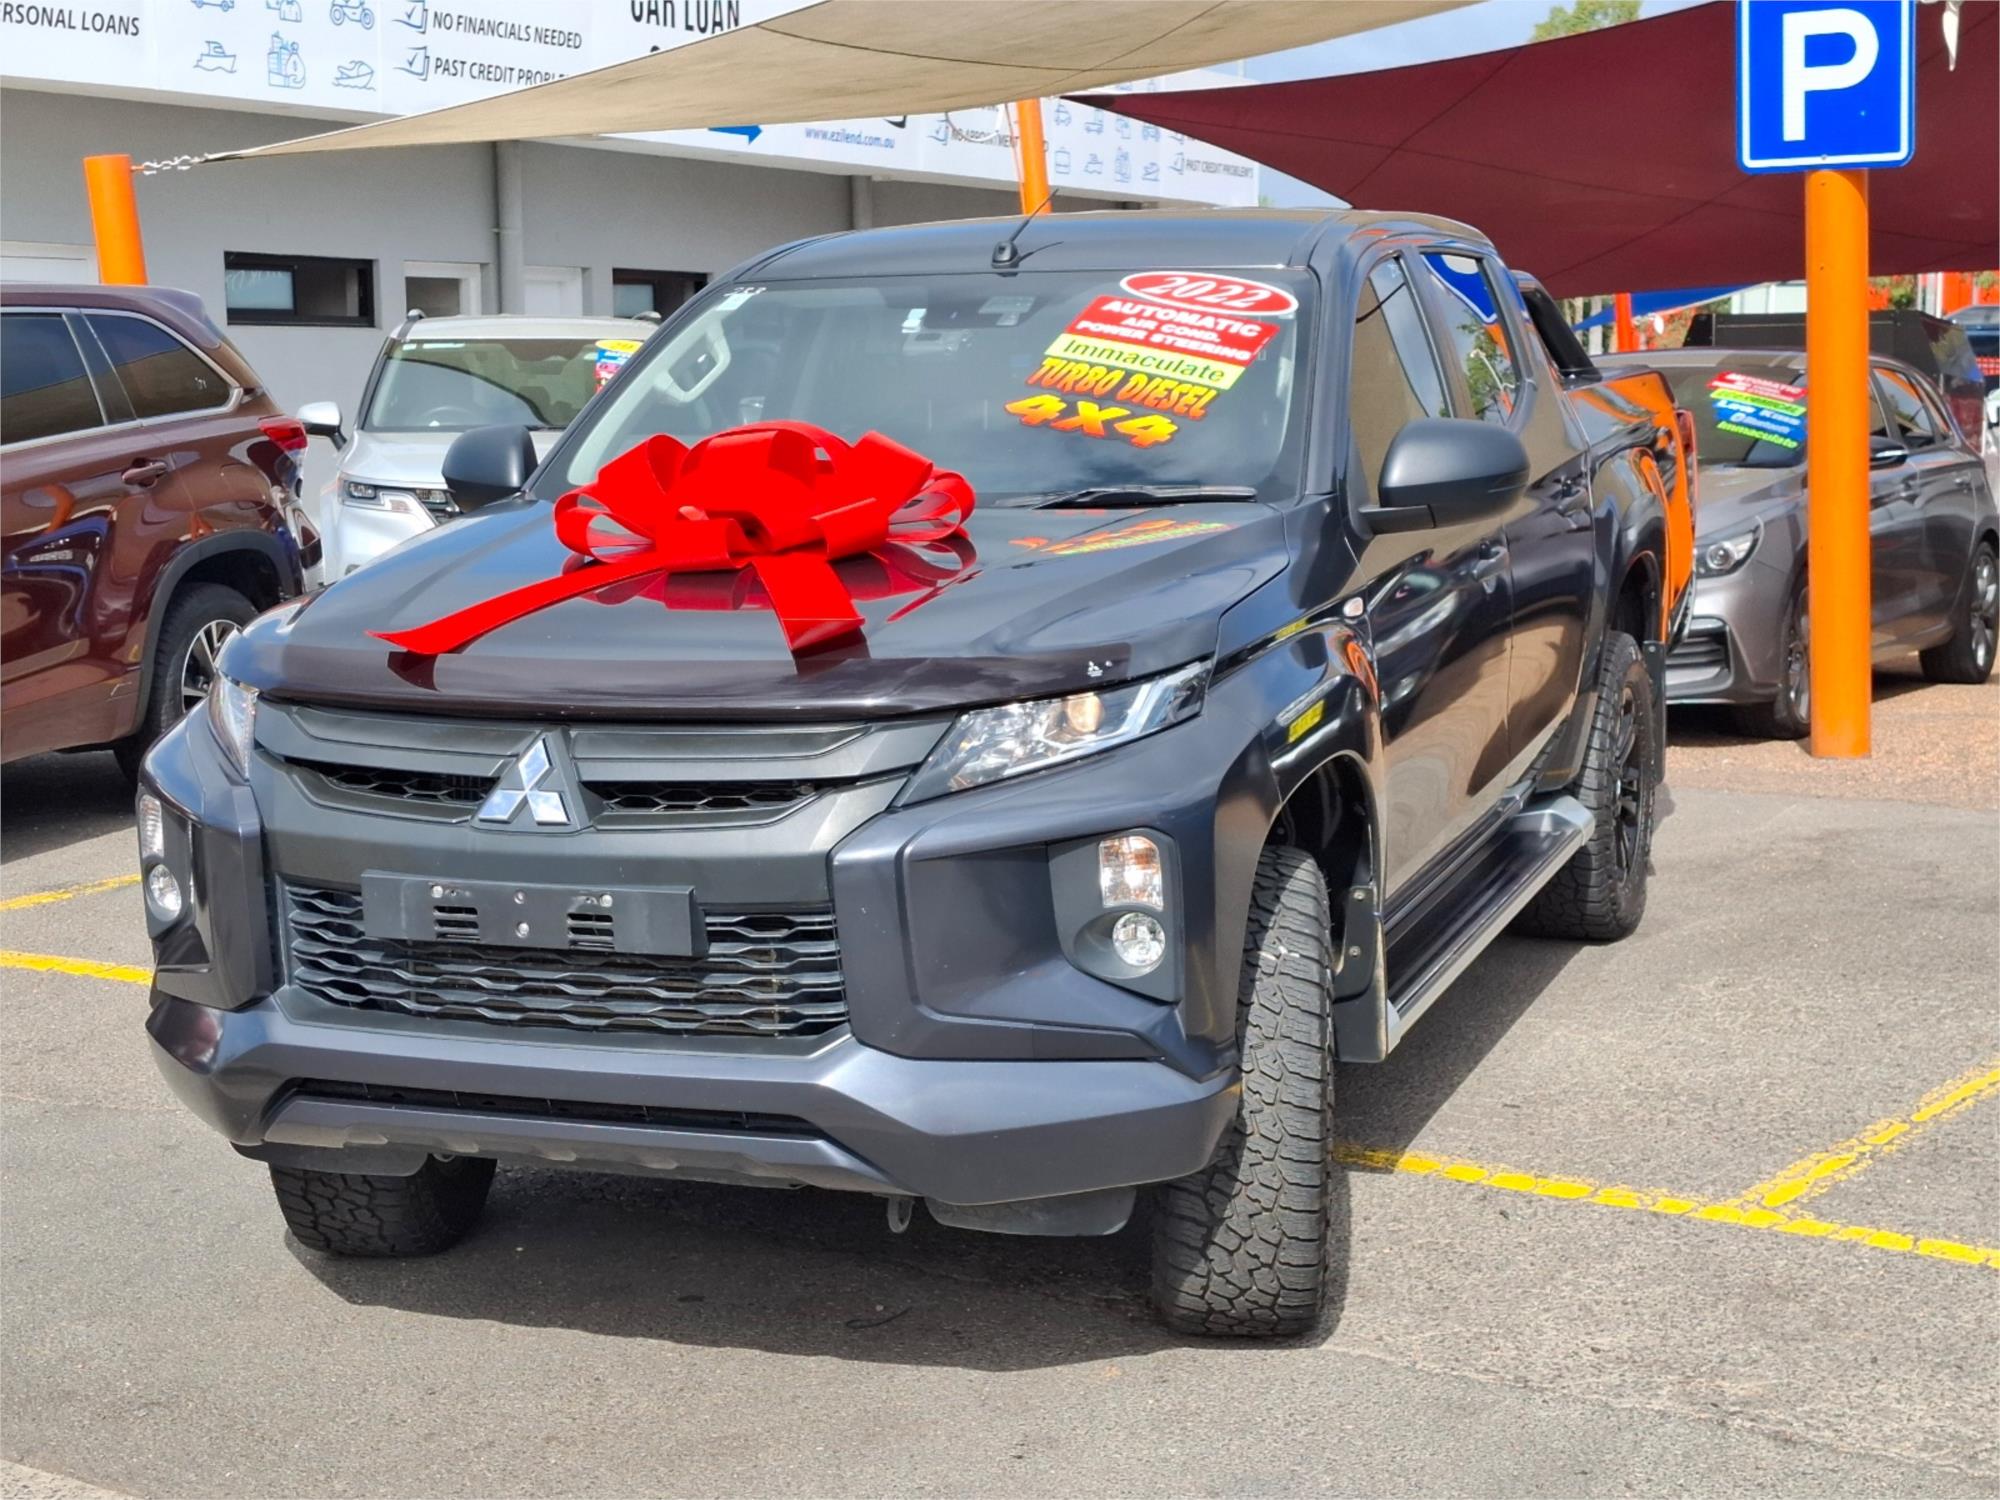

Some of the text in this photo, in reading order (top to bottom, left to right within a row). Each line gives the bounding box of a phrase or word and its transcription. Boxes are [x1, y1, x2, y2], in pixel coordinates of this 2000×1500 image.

[0, 2, 139, 36] RSONAL LOANS
[433, 11, 582, 49] NO FINANCIALS NEEDED
[434, 57, 466, 77] PAST
[469, 62, 514, 83] CREDIT
[1783, 9, 1879, 141] P
[1140, 276, 1272, 309] 2022
[1102, 300, 1262, 338] AUTOMATIC
[1121, 316, 1222, 343] AIR COND.
[1076, 320, 1252, 361] POWER STEERING
[1063, 339, 1225, 383] Immaculate
[1026, 357, 1218, 420] TURBO DIESEL
